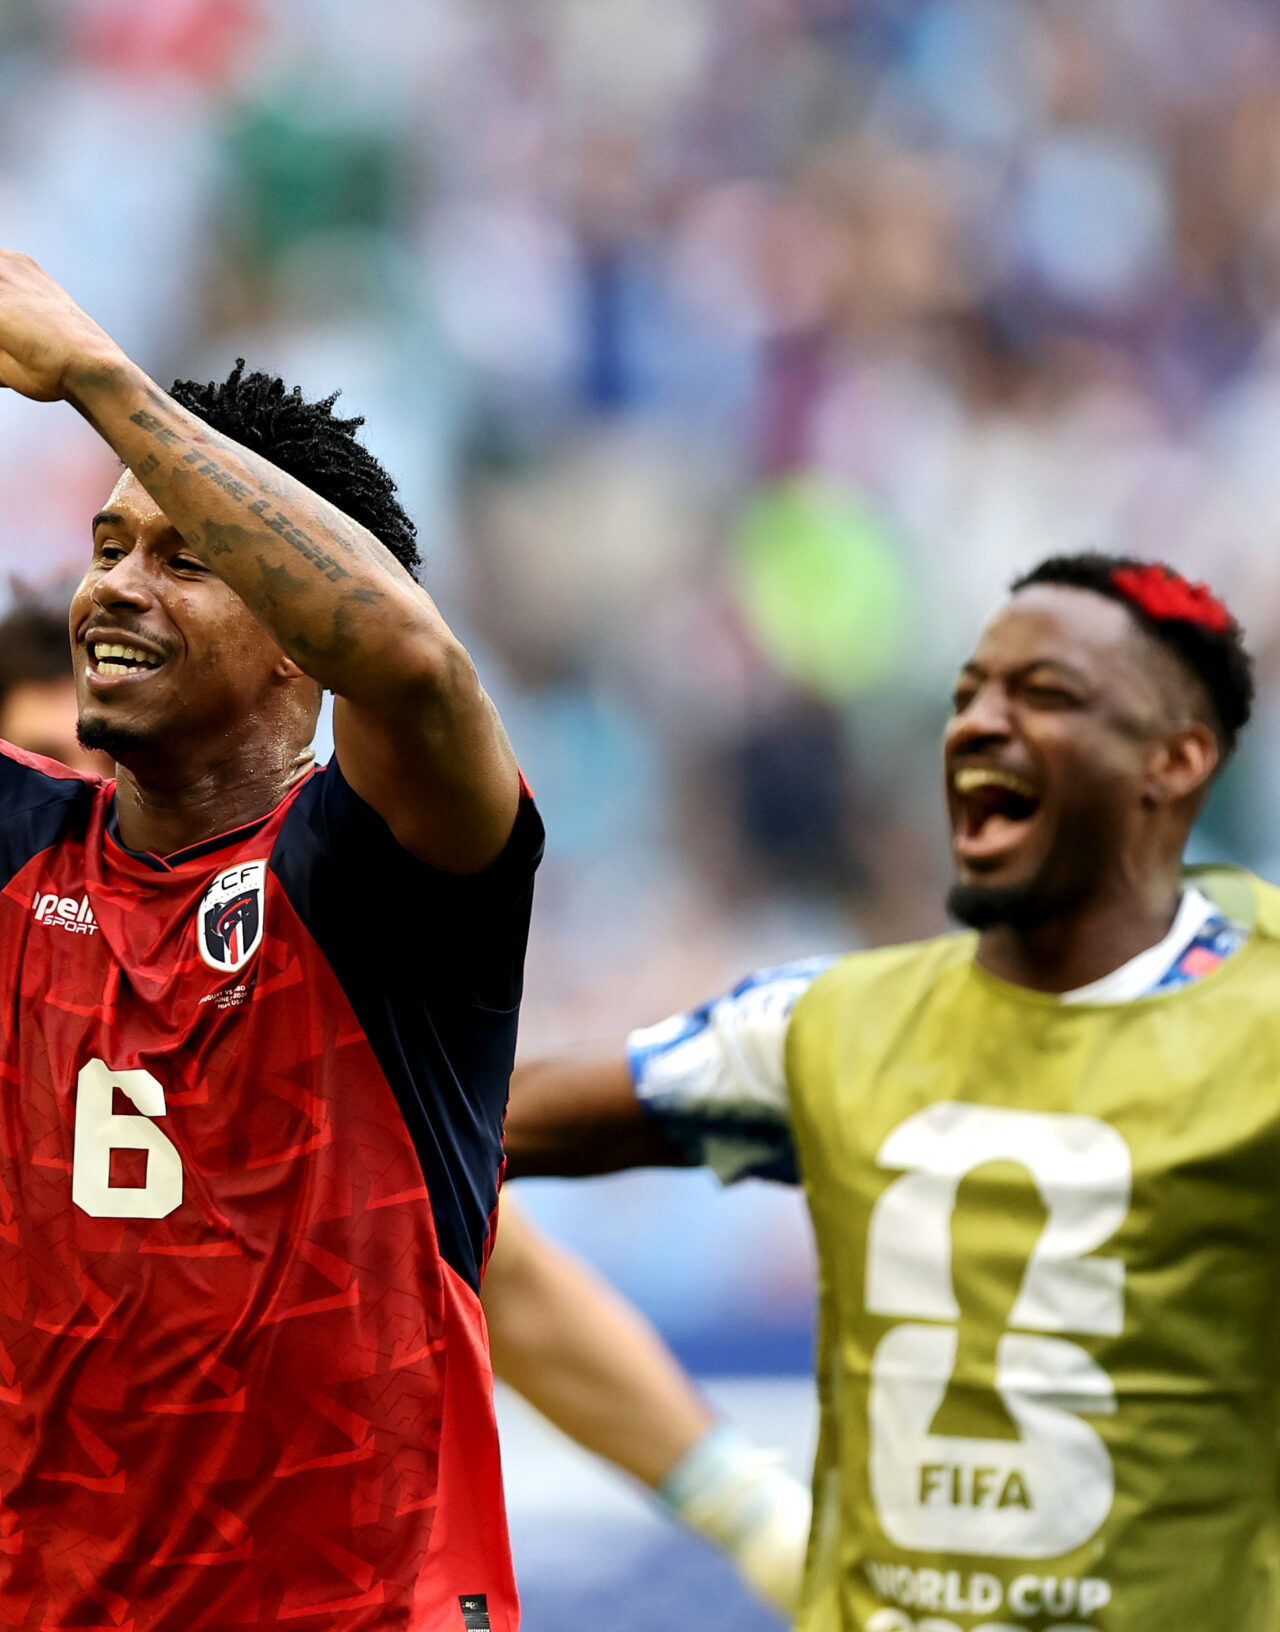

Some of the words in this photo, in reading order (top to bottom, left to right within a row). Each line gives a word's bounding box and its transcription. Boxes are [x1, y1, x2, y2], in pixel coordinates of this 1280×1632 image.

[203, 865, 259, 902] FCF
[42, 915, 99, 936] SPORT
[72, 1057, 183, 1219] 6
[918, 1464, 1033, 1511] FIFA
[865, 1560, 1003, 1615] WORLD
[1007, 1573, 1113, 1618] CUP
